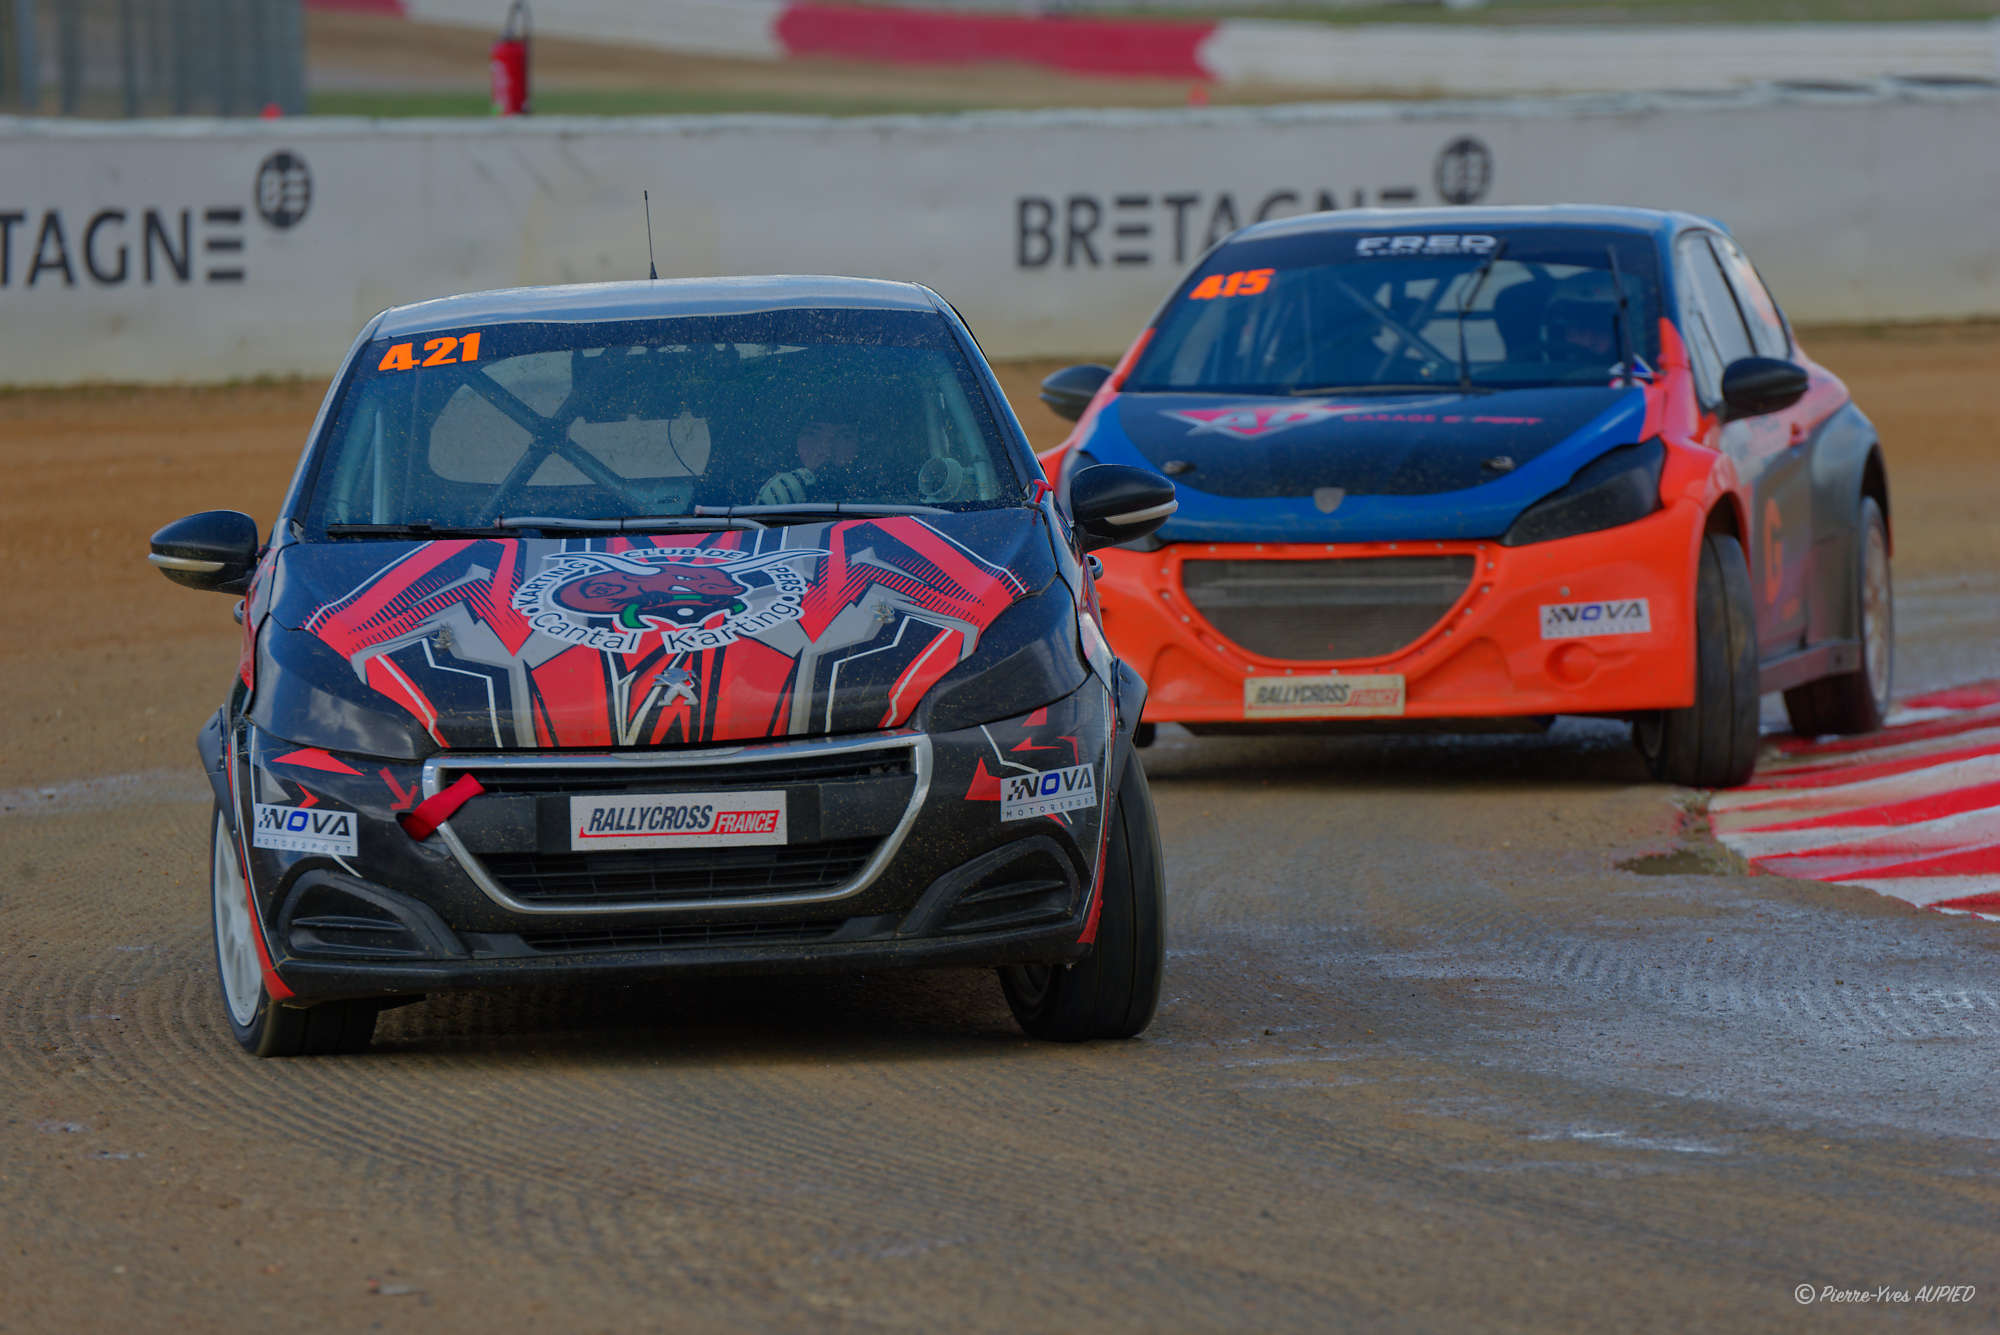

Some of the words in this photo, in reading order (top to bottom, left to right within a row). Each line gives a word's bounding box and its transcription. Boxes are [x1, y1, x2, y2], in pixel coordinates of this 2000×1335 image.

[1017, 187, 1418, 267] BRETA
[1188, 268, 1276, 300] 415
[378, 332, 480, 371] 421
[518, 560, 589, 607] KARTING
[624, 548, 697, 558] CLUB
[706, 550, 743, 559] DE
[534, 612, 637, 650] Cantal
[669, 601, 800, 650] Karting
[1547, 602, 1642, 624] NOVA
[1007, 767, 1092, 801] NOVA
[259, 807, 350, 836] NOVA
[588, 805, 713, 832] RALLYCROSS
[716, 812, 777, 833] FRANCE
